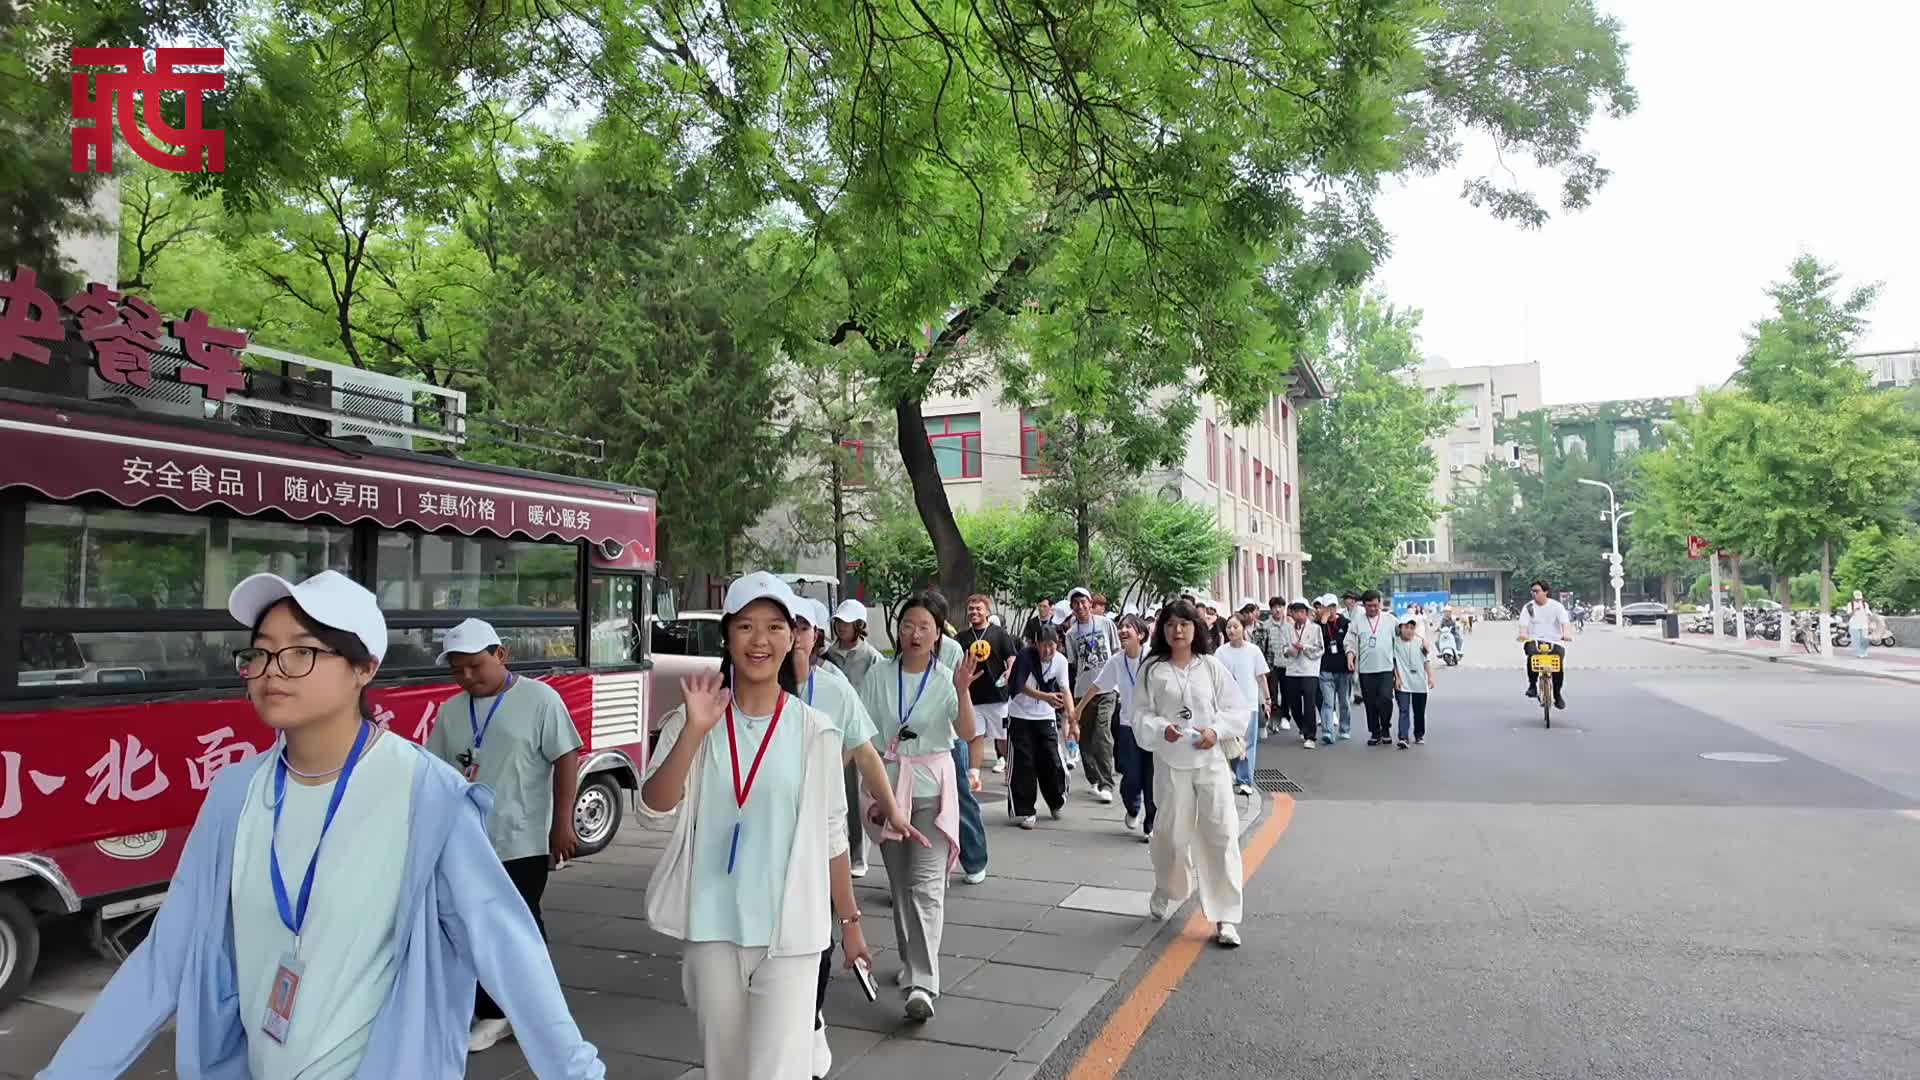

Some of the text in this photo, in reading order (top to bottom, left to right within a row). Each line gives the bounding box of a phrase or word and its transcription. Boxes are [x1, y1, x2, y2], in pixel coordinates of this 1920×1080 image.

[122, 456, 592, 530] 安全食品 随心享用 实惠价格 暖心服务
